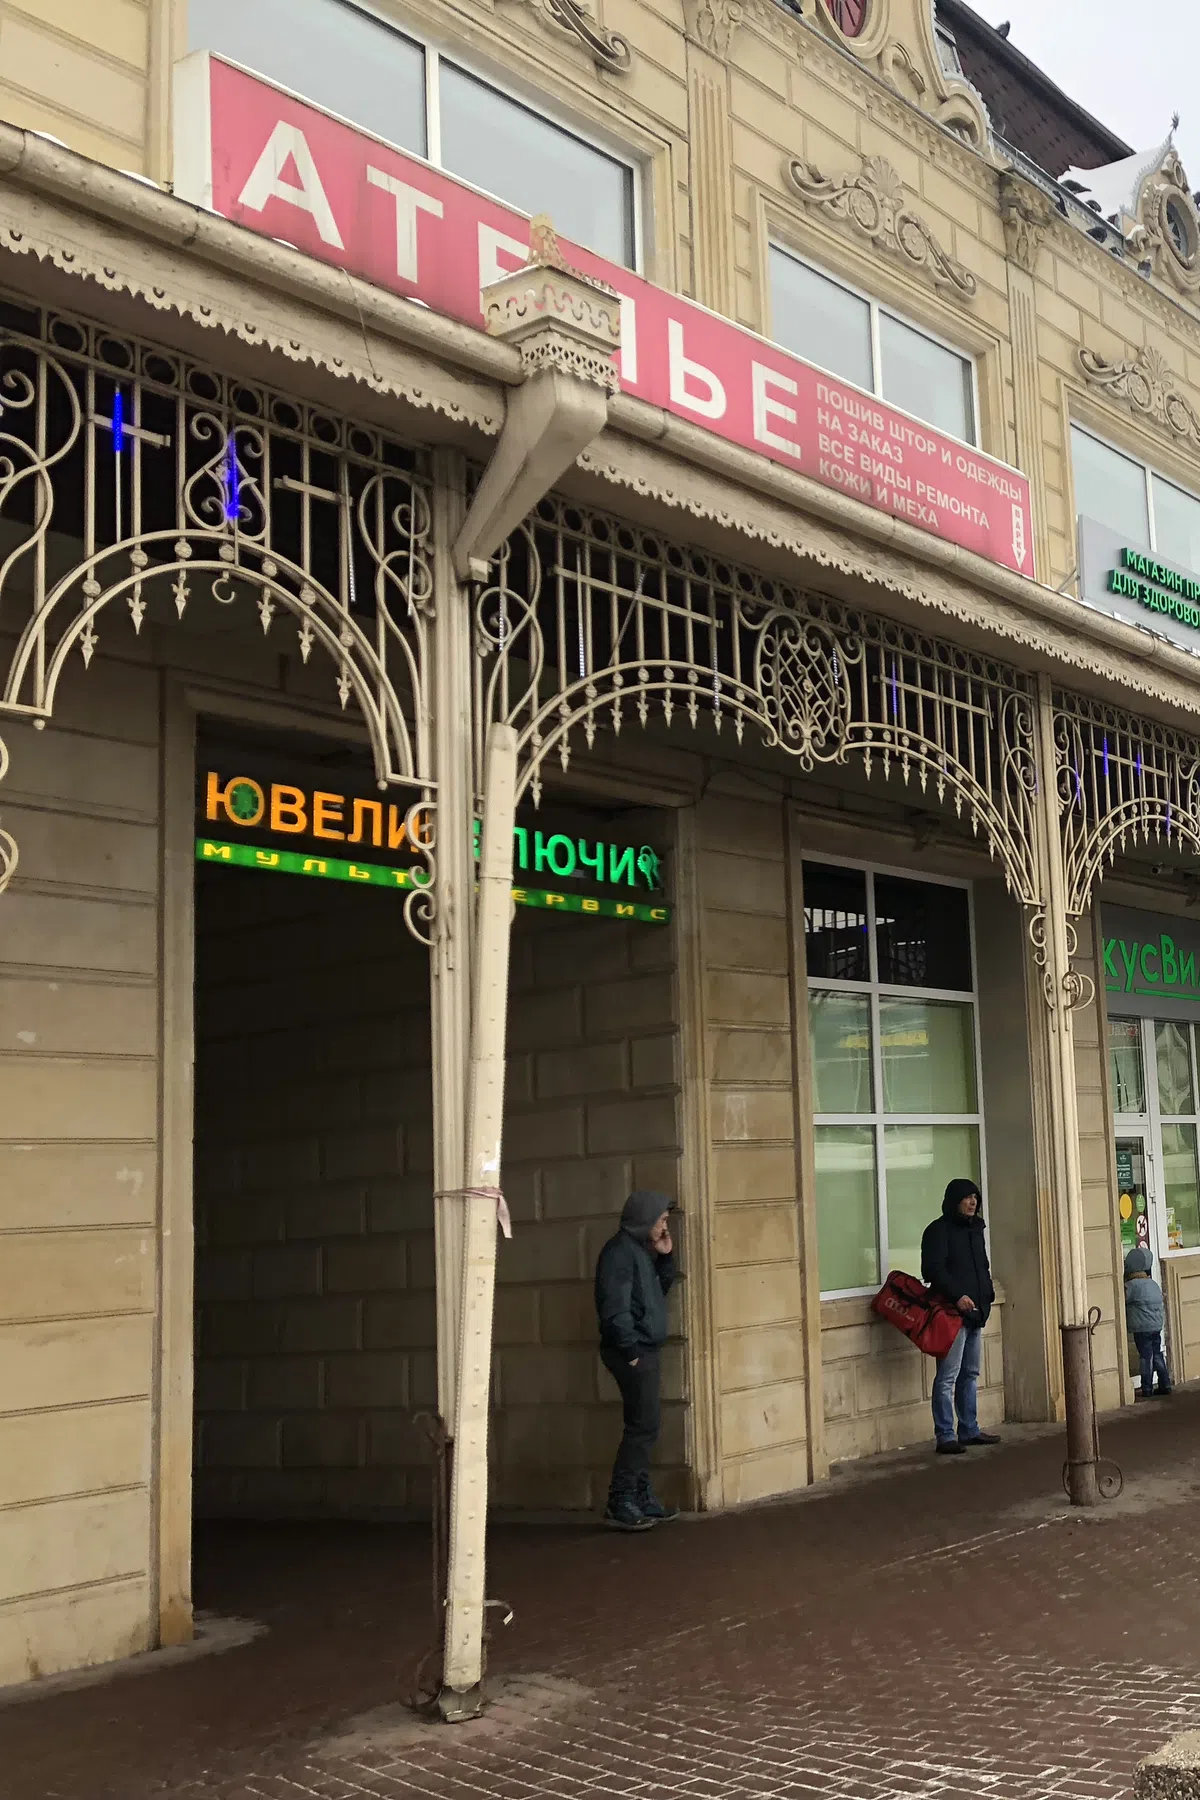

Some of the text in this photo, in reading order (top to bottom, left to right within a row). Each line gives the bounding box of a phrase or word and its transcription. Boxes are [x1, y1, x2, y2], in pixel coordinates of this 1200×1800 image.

[816, 383, 1022, 502] ПОШИВ ШТОР И ОДЕЖДЫ
[817, 408, 903, 464] НА ЗАКАЗ
[818, 432, 990, 529] ВСЕ ВИДЫ РЕМОНТА
[819, 458, 939, 527] КОЖИ И МЕХА
[1109, 570, 1140, 598] ДЛЯ
[1122, 548, 1183, 592] МАГАЗИН
[206, 771, 635, 887] ЮВЕЛИ ЛЮЧИ
